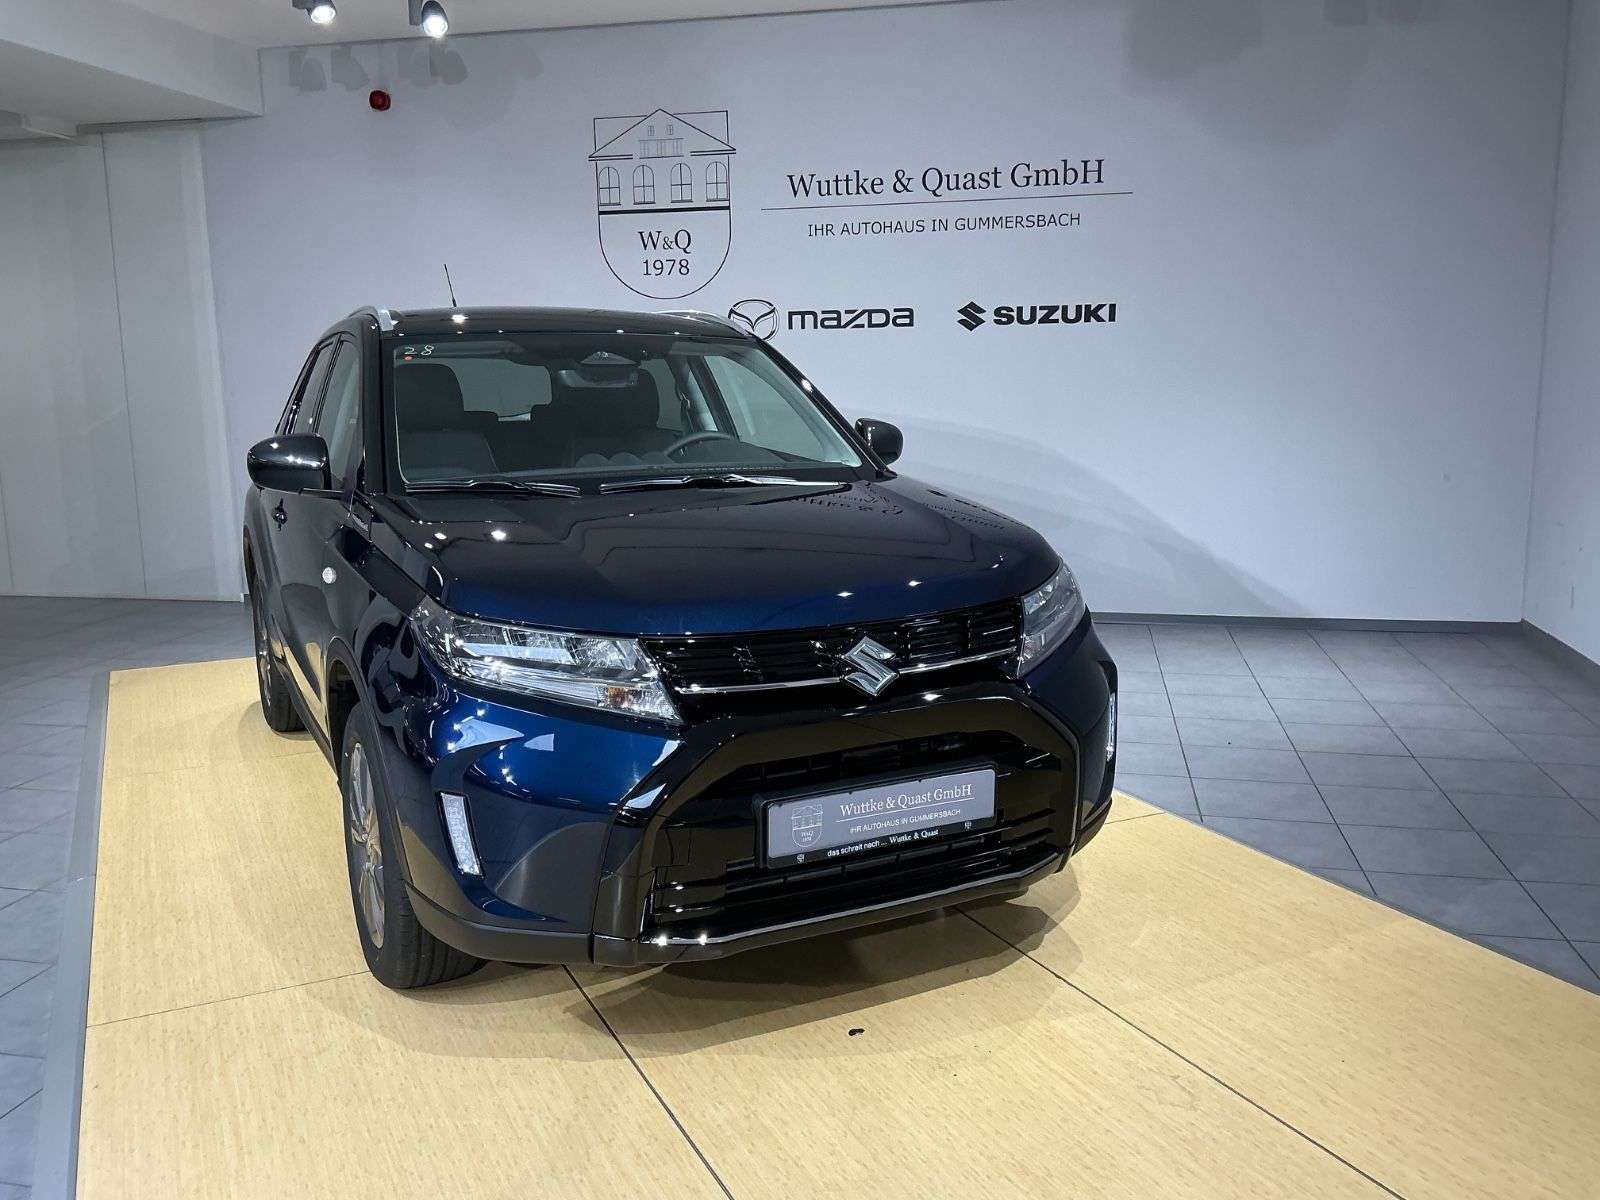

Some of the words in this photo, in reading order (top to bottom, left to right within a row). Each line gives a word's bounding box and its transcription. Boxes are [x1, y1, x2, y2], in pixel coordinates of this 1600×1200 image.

[786, 170, 885, 198] Wuttke
[893, 168, 914, 194] &
[921, 166, 1003, 197] Quast
[1009, 158, 1105, 188] GmbH
[807, 223, 836, 238] IHR
[840, 217, 926, 235] AUTOHAUS
[931, 218, 949, 232] IN
[954, 212, 1081, 232] GUMMERSBACH
[638, 228, 692, 254] W&Q
[640, 257, 690, 277] 1978
[992, 303, 1117, 326] SUZUKI
[840, 800, 883, 816] Wuttke
[886, 796, 896, 809] &
[897, 791, 932, 809] Quast
[933, 784, 972, 798] GmbH
[862, 819, 899, 831] AUTOHAUS
[910, 809, 961, 823] GUMMERSBACH
[827, 849, 840, 857] das
[889, 834, 912, 845] Wuttke
[920, 829, 940, 839] Quast
